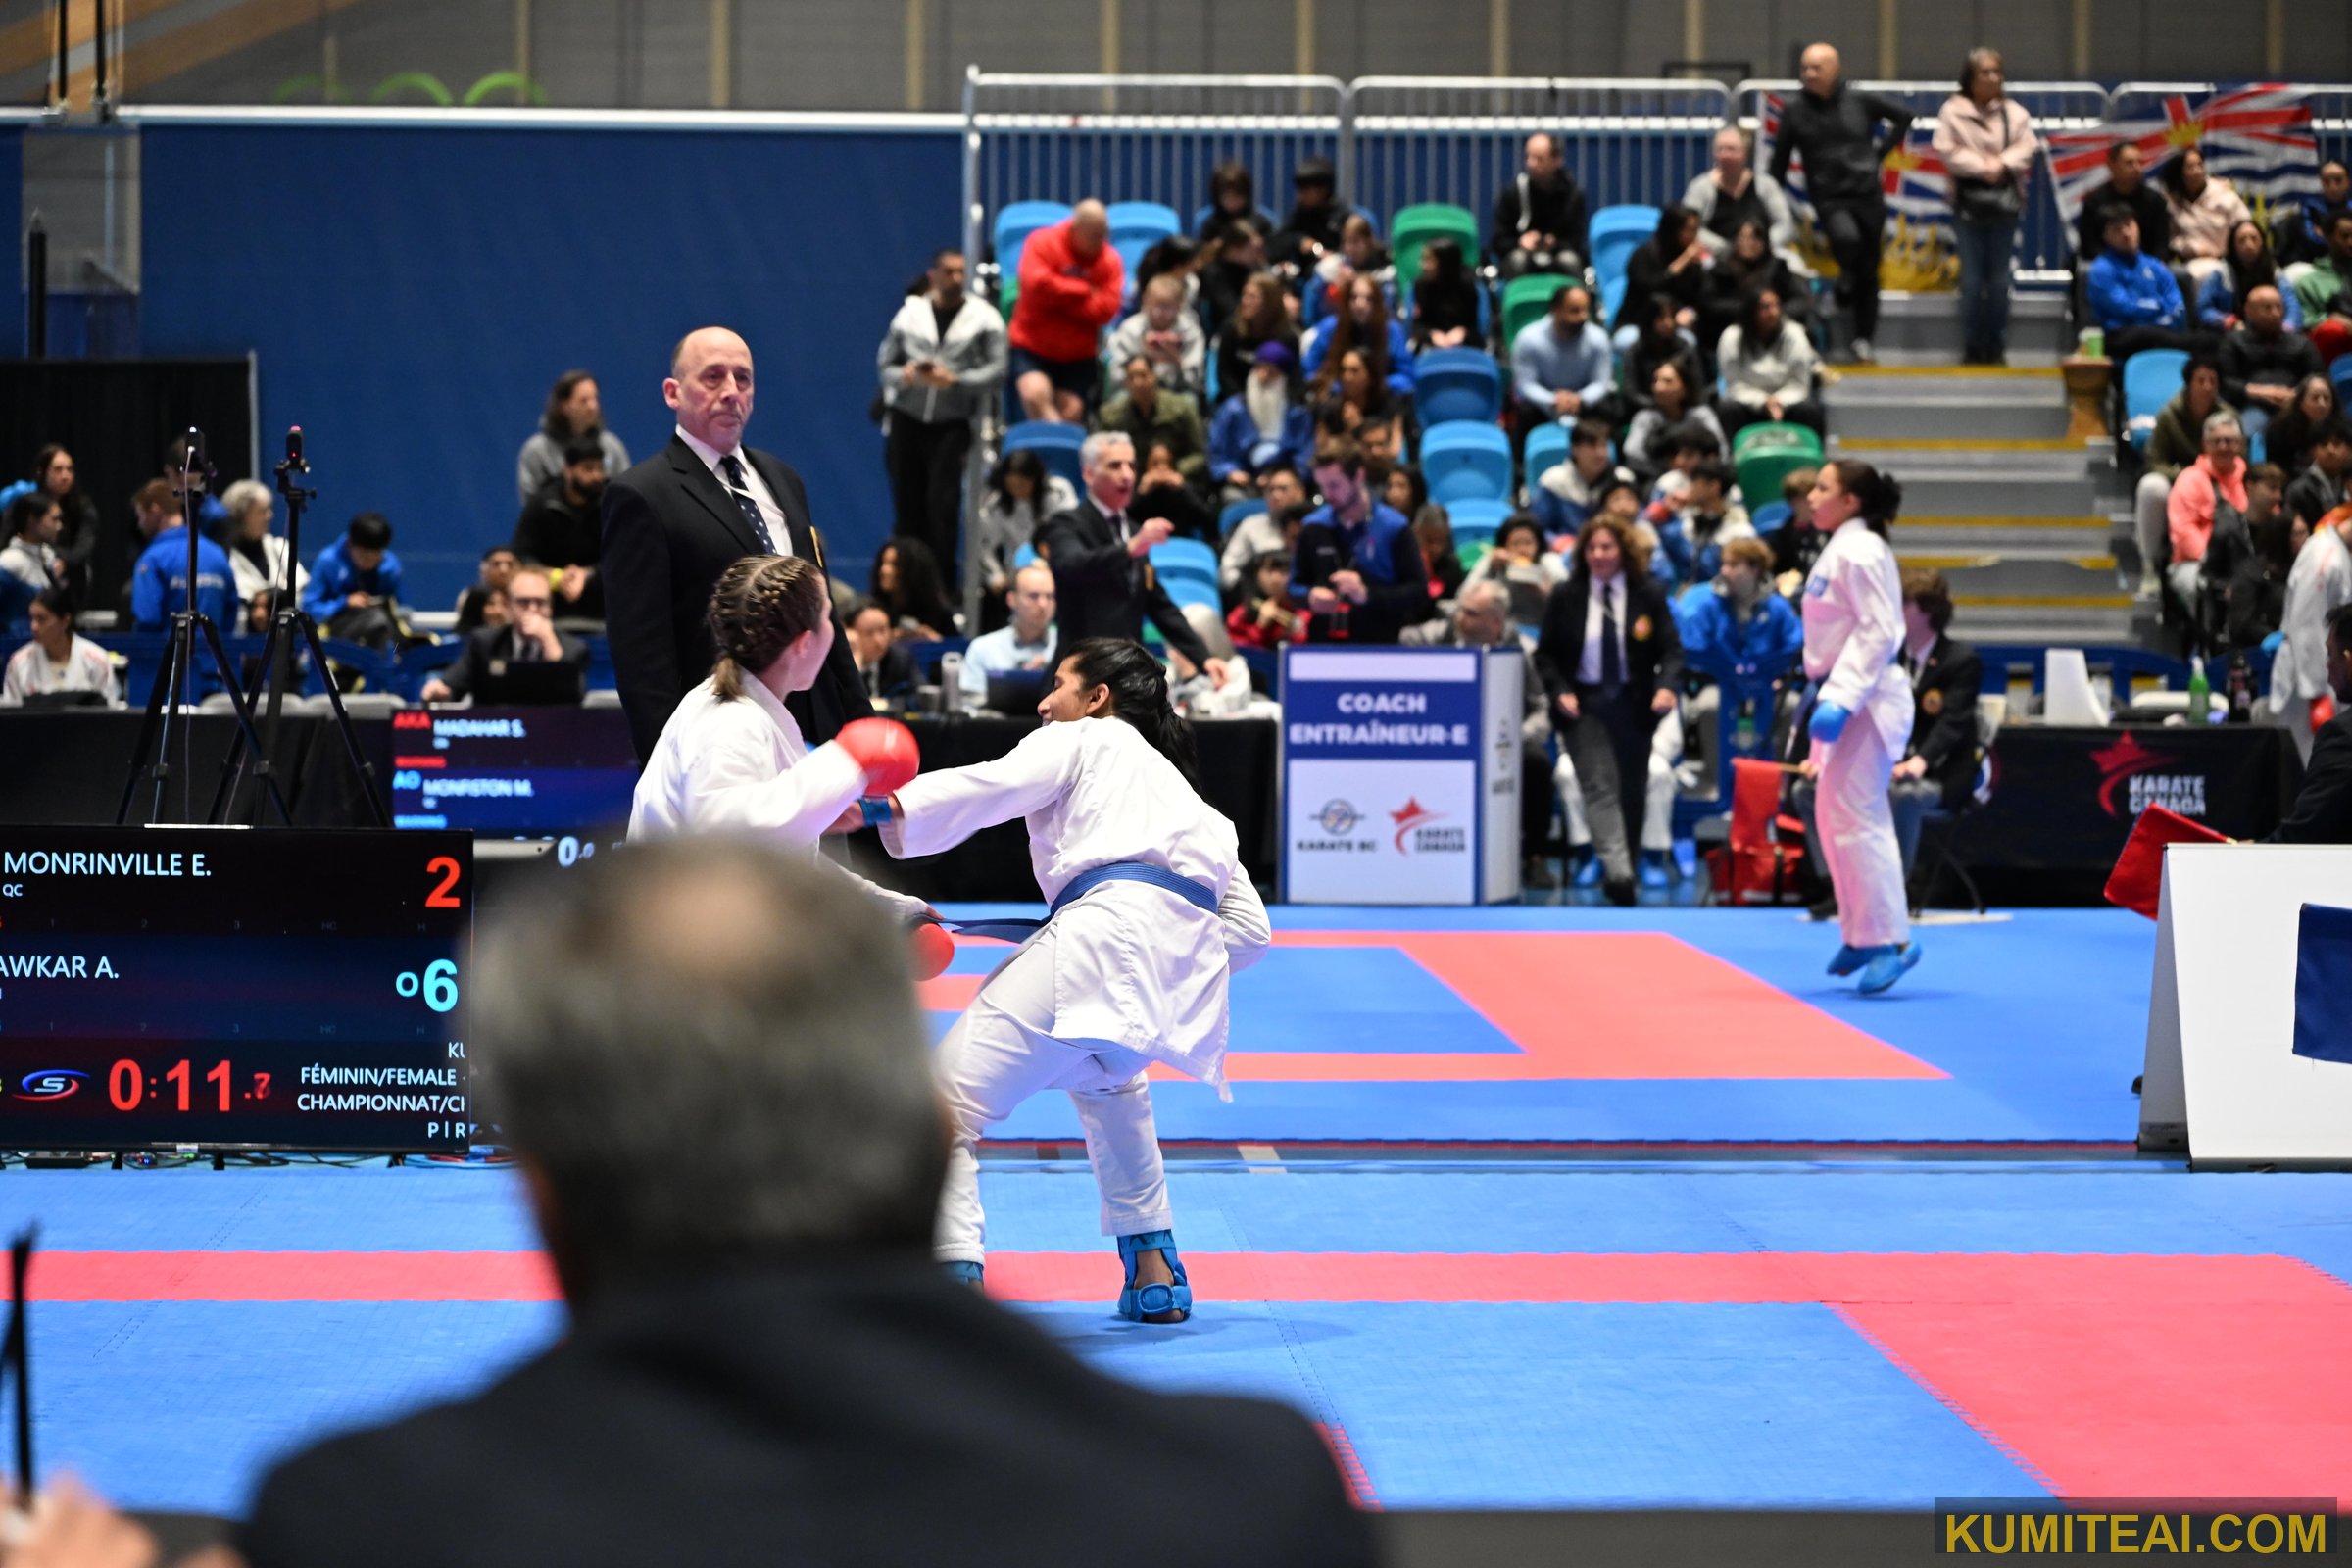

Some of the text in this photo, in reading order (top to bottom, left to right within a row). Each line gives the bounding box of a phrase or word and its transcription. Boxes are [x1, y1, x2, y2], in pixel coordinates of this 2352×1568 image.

[1337, 693, 1427, 713] COACH
[393, 770, 421, 789] AO
[2129, 775, 2205, 795] KARATE
[4, 851, 212, 876] MONRINVILLE E.
[2, 883, 24, 897] QC
[425, 857, 461, 907] 2
[94, 956, 120, 979] A.
[301, 1062, 457, 1087] FÉMININ/FEMALE
[297, 1094, 466, 1113] CHAMPIONNAT/C
